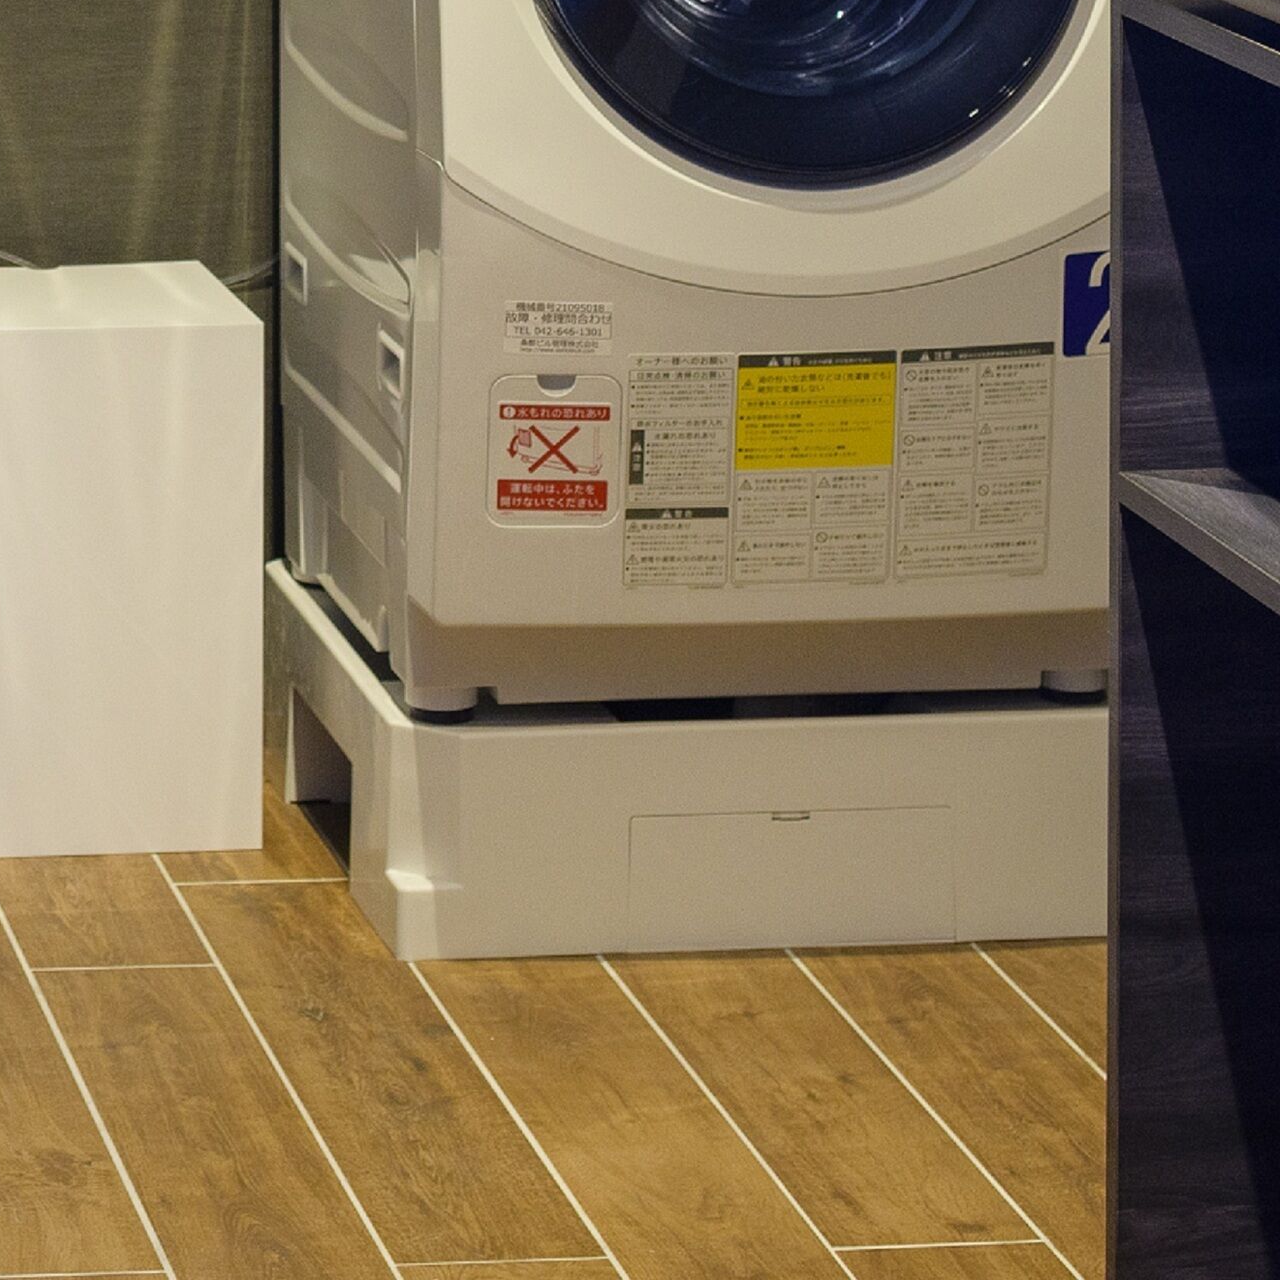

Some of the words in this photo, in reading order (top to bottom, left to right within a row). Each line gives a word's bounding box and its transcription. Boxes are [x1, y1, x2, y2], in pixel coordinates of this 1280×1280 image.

[515, 303, 605, 313] 機械番号21095018
[505, 313, 612, 325] 故障・修理問合わせ
[514, 327, 529, 335] TEL
[534, 327, 603, 337] 042-646-1301
[635, 356, 728, 366] オーナー様へのお願い
[782, 355, 802, 366] 警告
[517, 407, 608, 418] 水もれの恐れあり
[510, 483, 595, 494] 運転中は、ふたを
[500, 496, 604, 508] 開けないでください。
